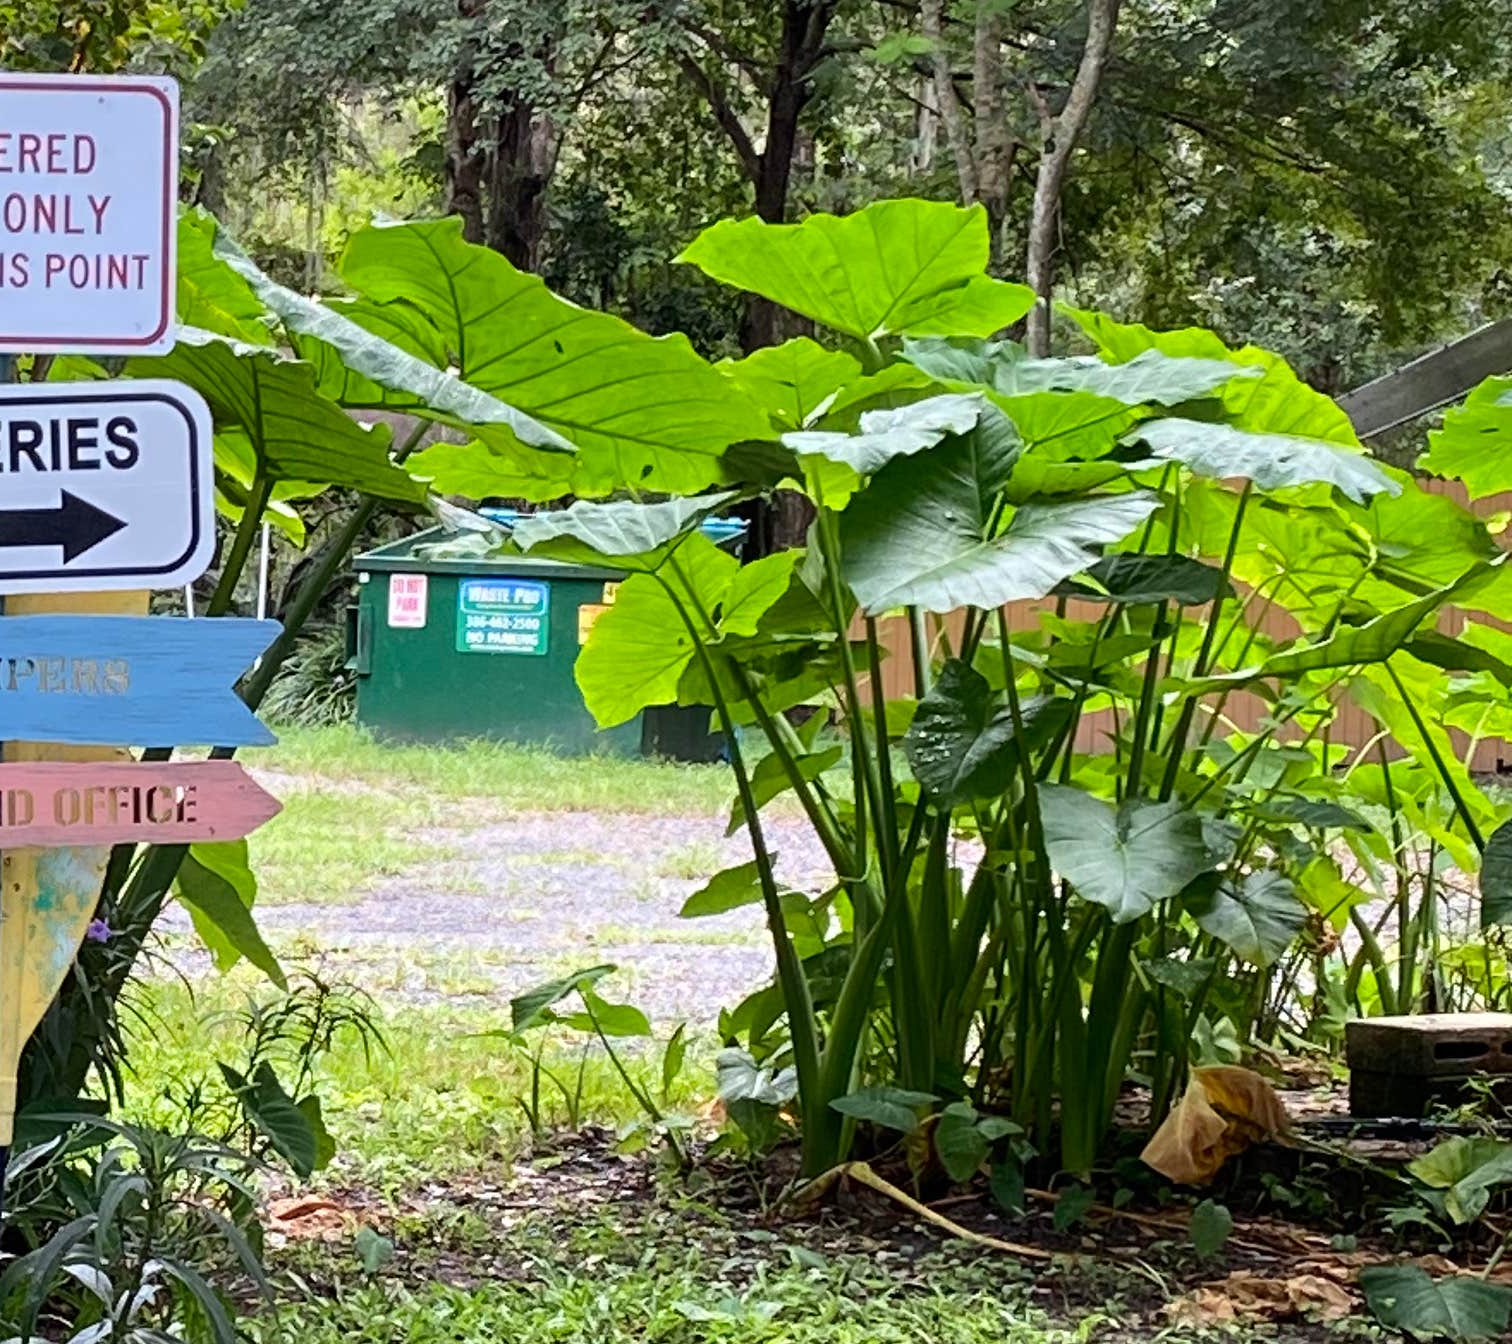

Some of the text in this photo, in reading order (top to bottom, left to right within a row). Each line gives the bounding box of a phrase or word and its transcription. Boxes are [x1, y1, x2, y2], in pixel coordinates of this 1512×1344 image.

[3, 193, 112, 235] ONLY
[45, 254, 150, 290] POINT
[466, 631, 538, 646] NO PARKING
[53, 785, 198, 828] OFFICE
